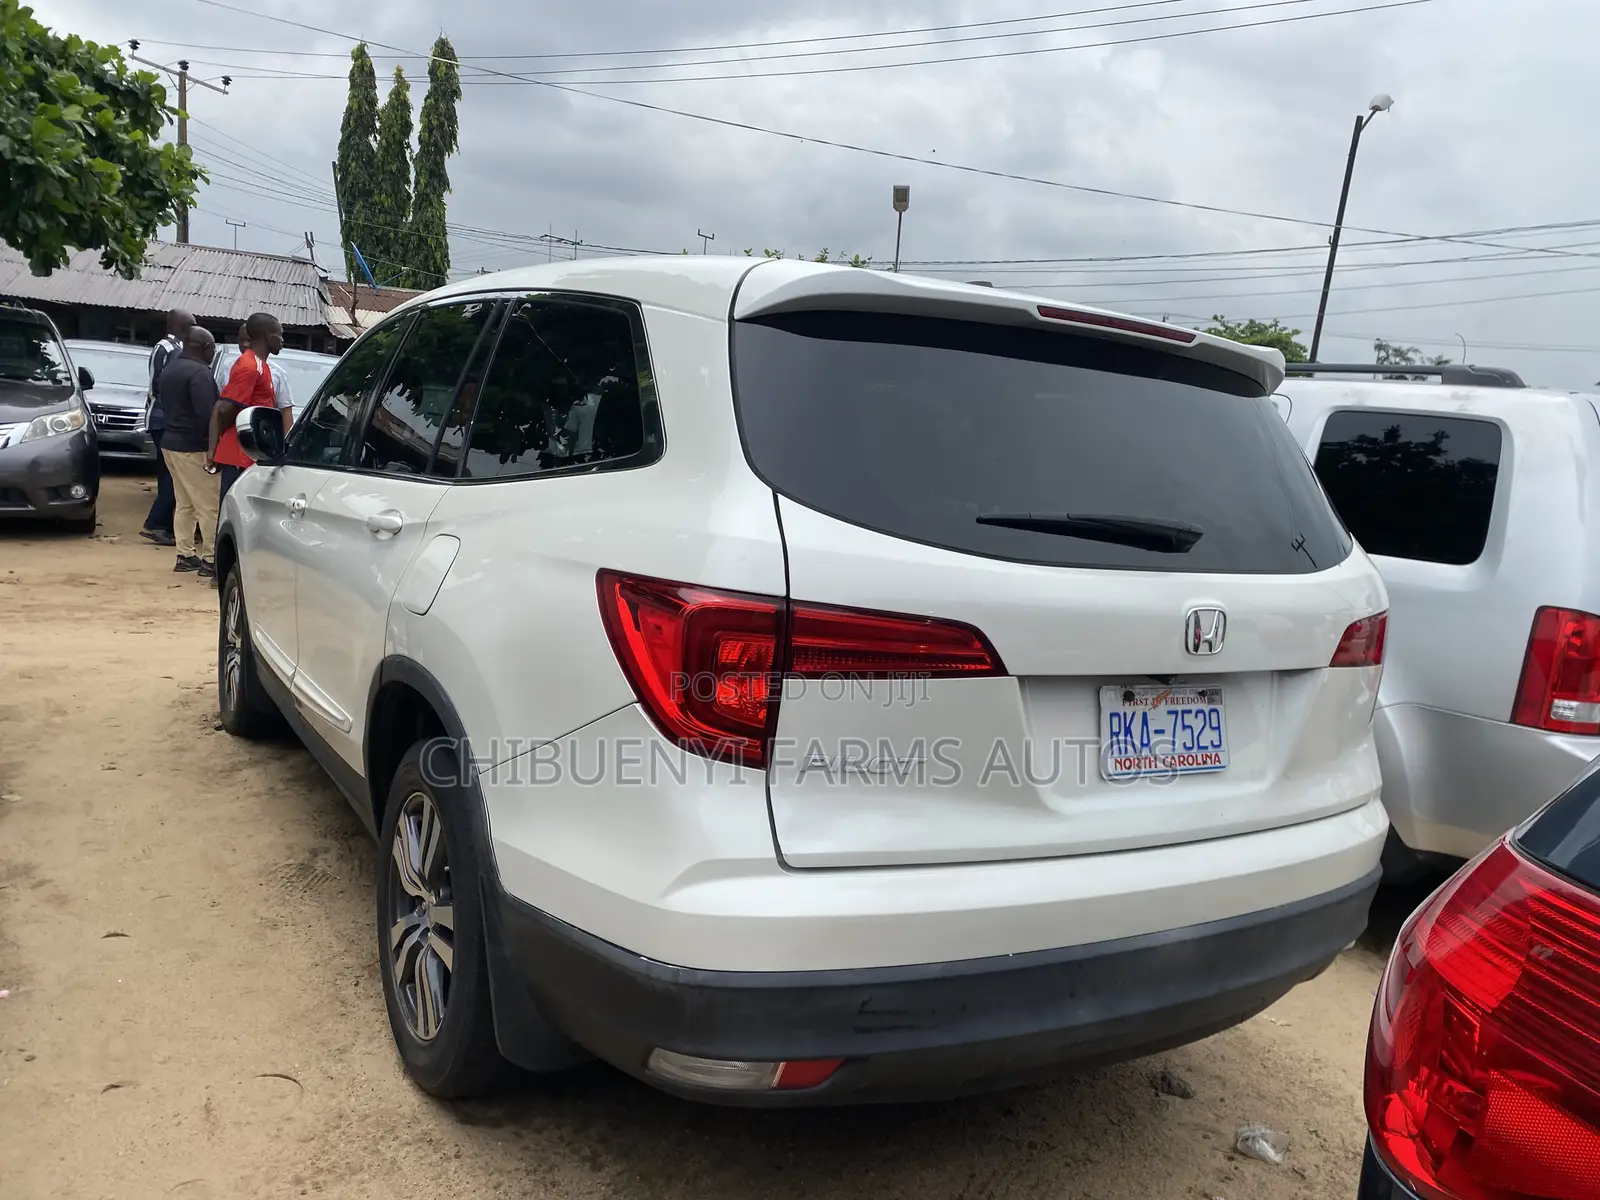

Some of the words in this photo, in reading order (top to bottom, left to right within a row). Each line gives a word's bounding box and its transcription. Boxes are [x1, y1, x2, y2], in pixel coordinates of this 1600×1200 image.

[1164, 695, 1208, 706] FREEDOM
[1109, 707, 1222, 756] RKA-7529
[1114, 755, 1158, 771] NORTH
[1162, 752, 1221, 769] CAROLINA
